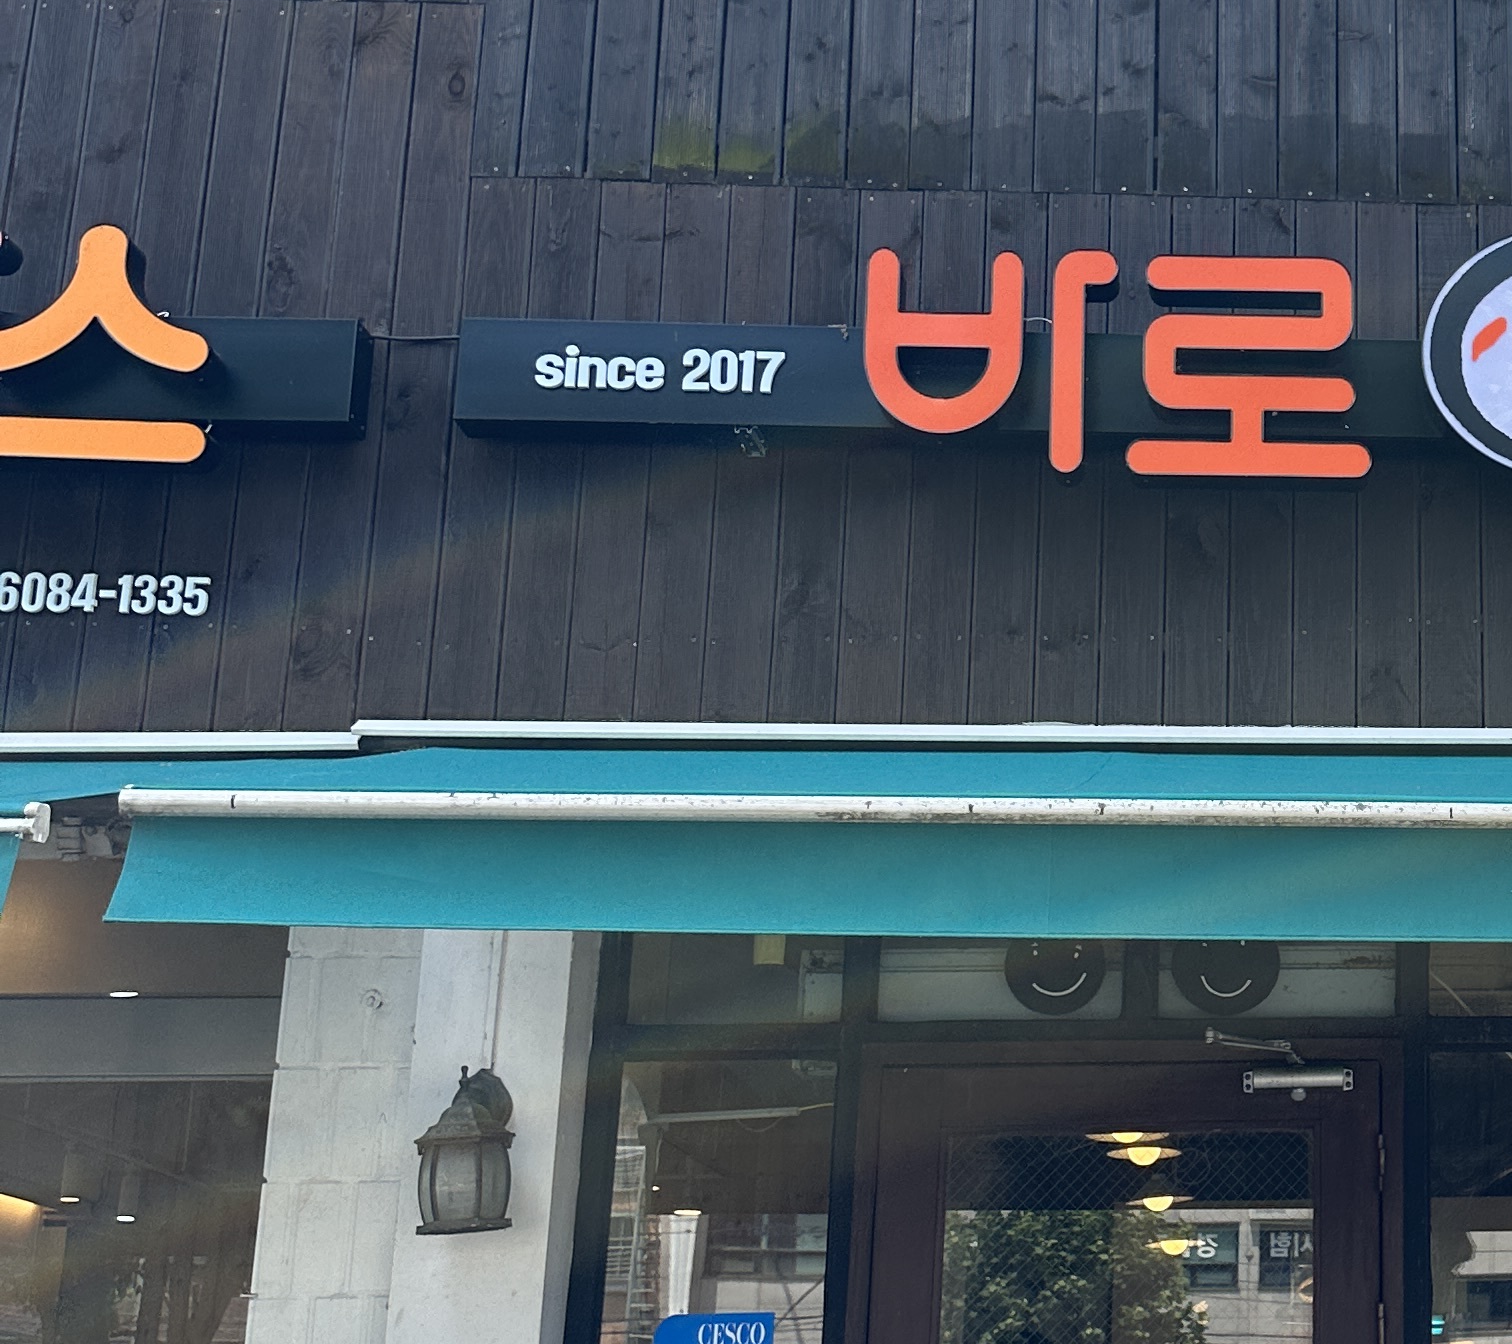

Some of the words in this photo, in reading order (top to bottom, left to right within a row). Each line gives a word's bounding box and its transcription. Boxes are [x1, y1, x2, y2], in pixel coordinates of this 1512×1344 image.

[534, 343, 665, 392] since
[681, 348, 786, 395] 2017
[864, 247, 1372, 478] 바로
